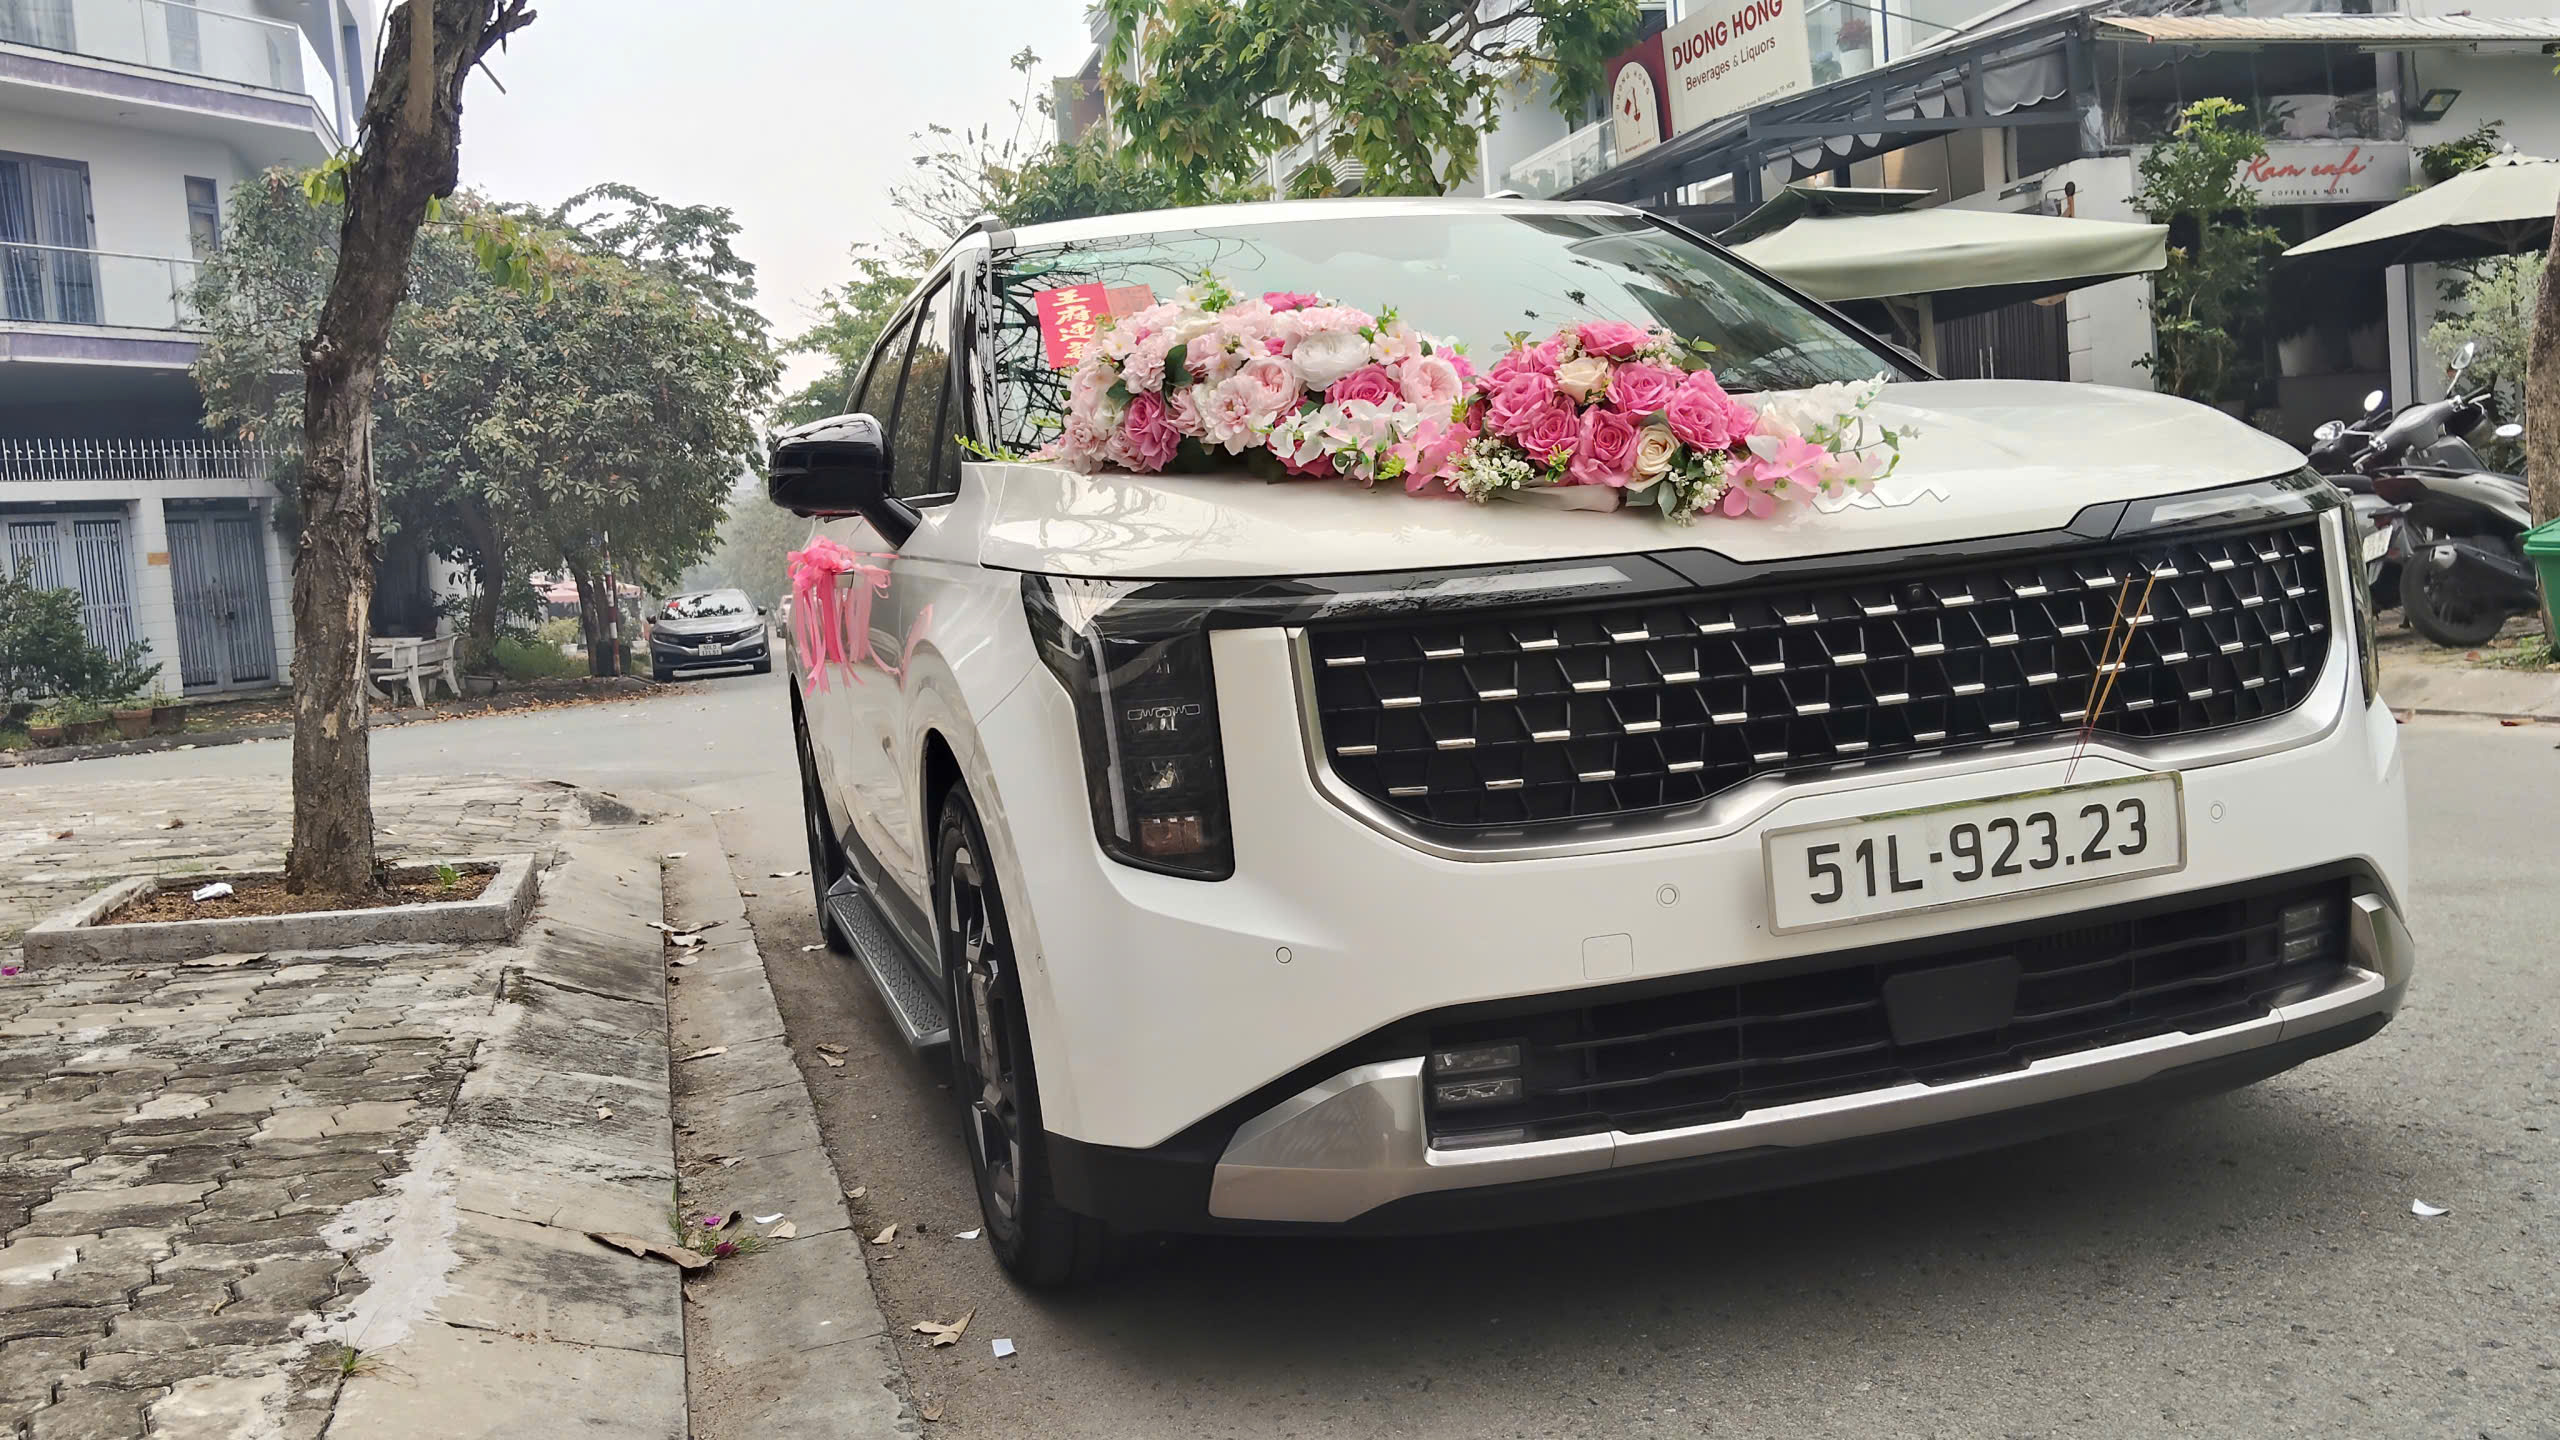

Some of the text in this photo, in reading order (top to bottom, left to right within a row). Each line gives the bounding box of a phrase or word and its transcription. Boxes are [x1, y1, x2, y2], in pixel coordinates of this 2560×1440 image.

[1672, 0, 1783, 71] DUONG HONG
[1686, 36, 1776, 91] Beverages & Liquors
[2271, 189, 2307, 197] COFFEE
[2323, 187, 2350, 196] MORE
[1807, 798, 2148, 905] 51L-923.23
